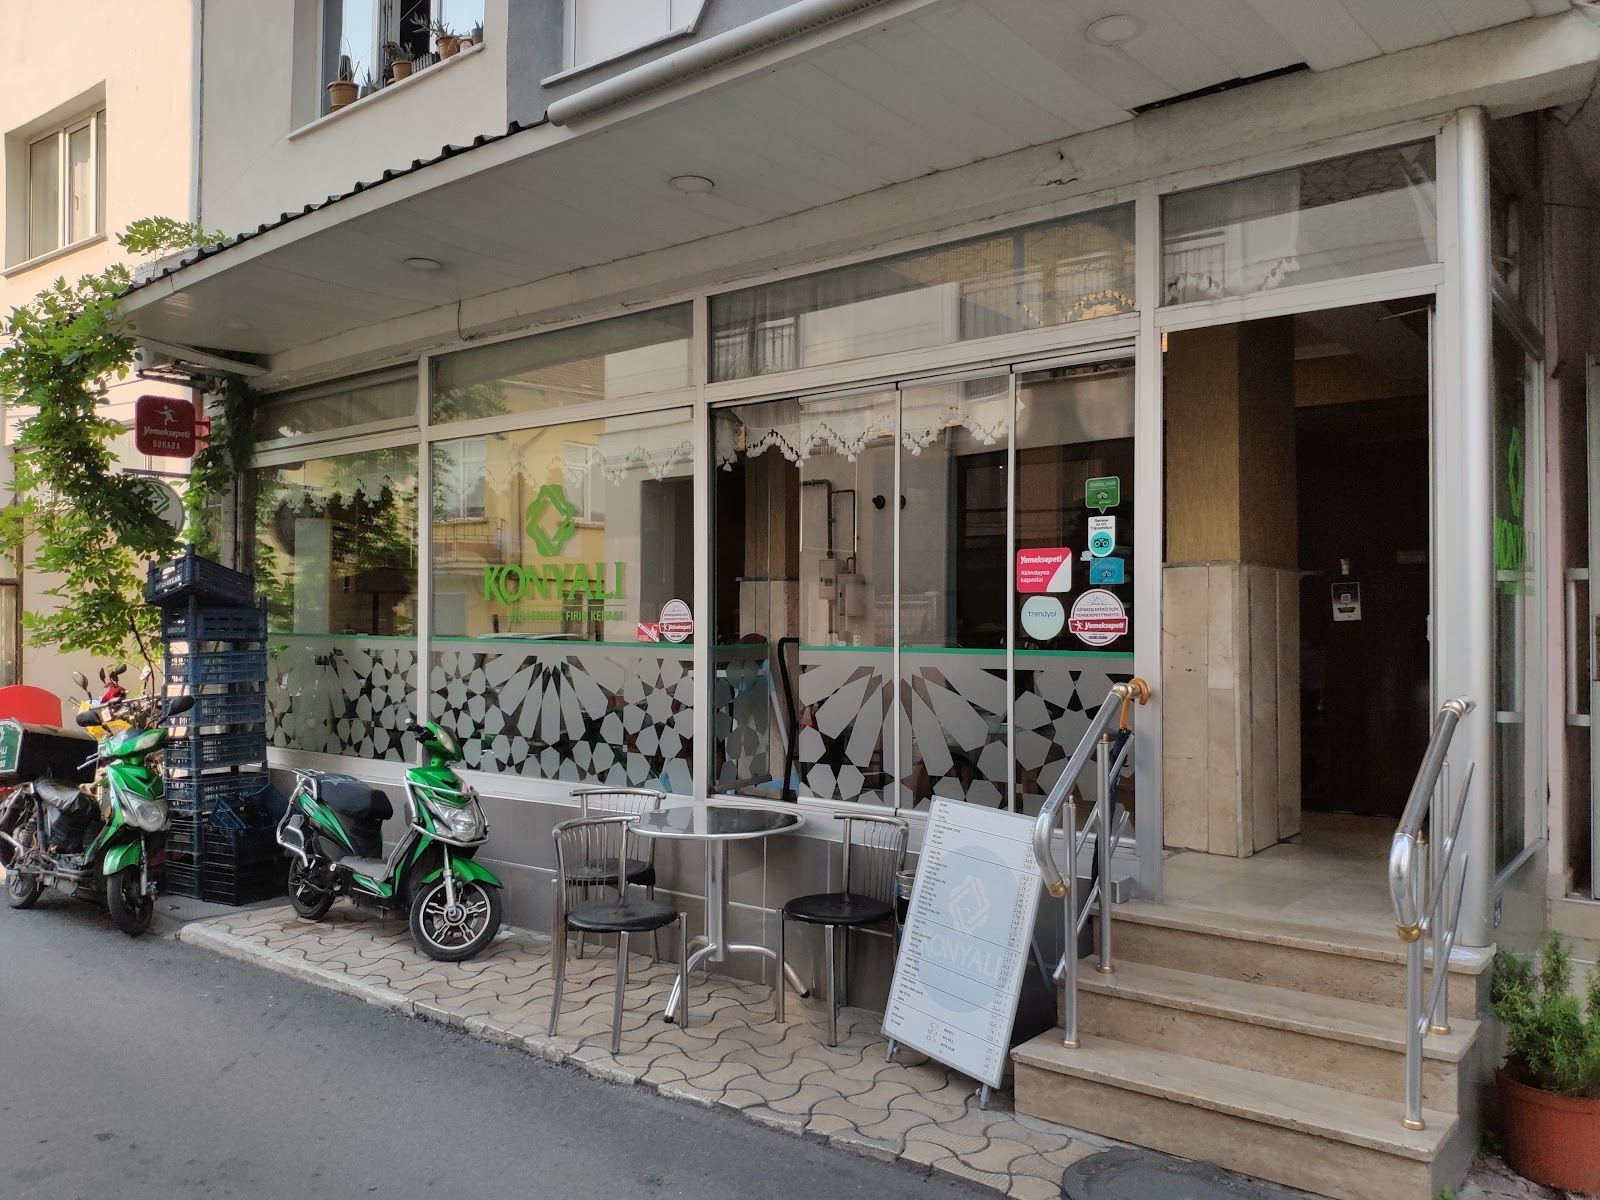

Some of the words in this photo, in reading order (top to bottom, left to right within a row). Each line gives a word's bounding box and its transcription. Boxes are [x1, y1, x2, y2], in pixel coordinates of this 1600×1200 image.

[143, 425, 191, 439] Yemeksepeti
[152, 439, 181, 450] BURADA
[1020, 555, 1063, 565] Yemeksepeti
[483, 561, 625, 607] KONYALI
[1028, 610, 1057, 618] trendyol
[1084, 621, 1124, 631] Yemeksepeti
